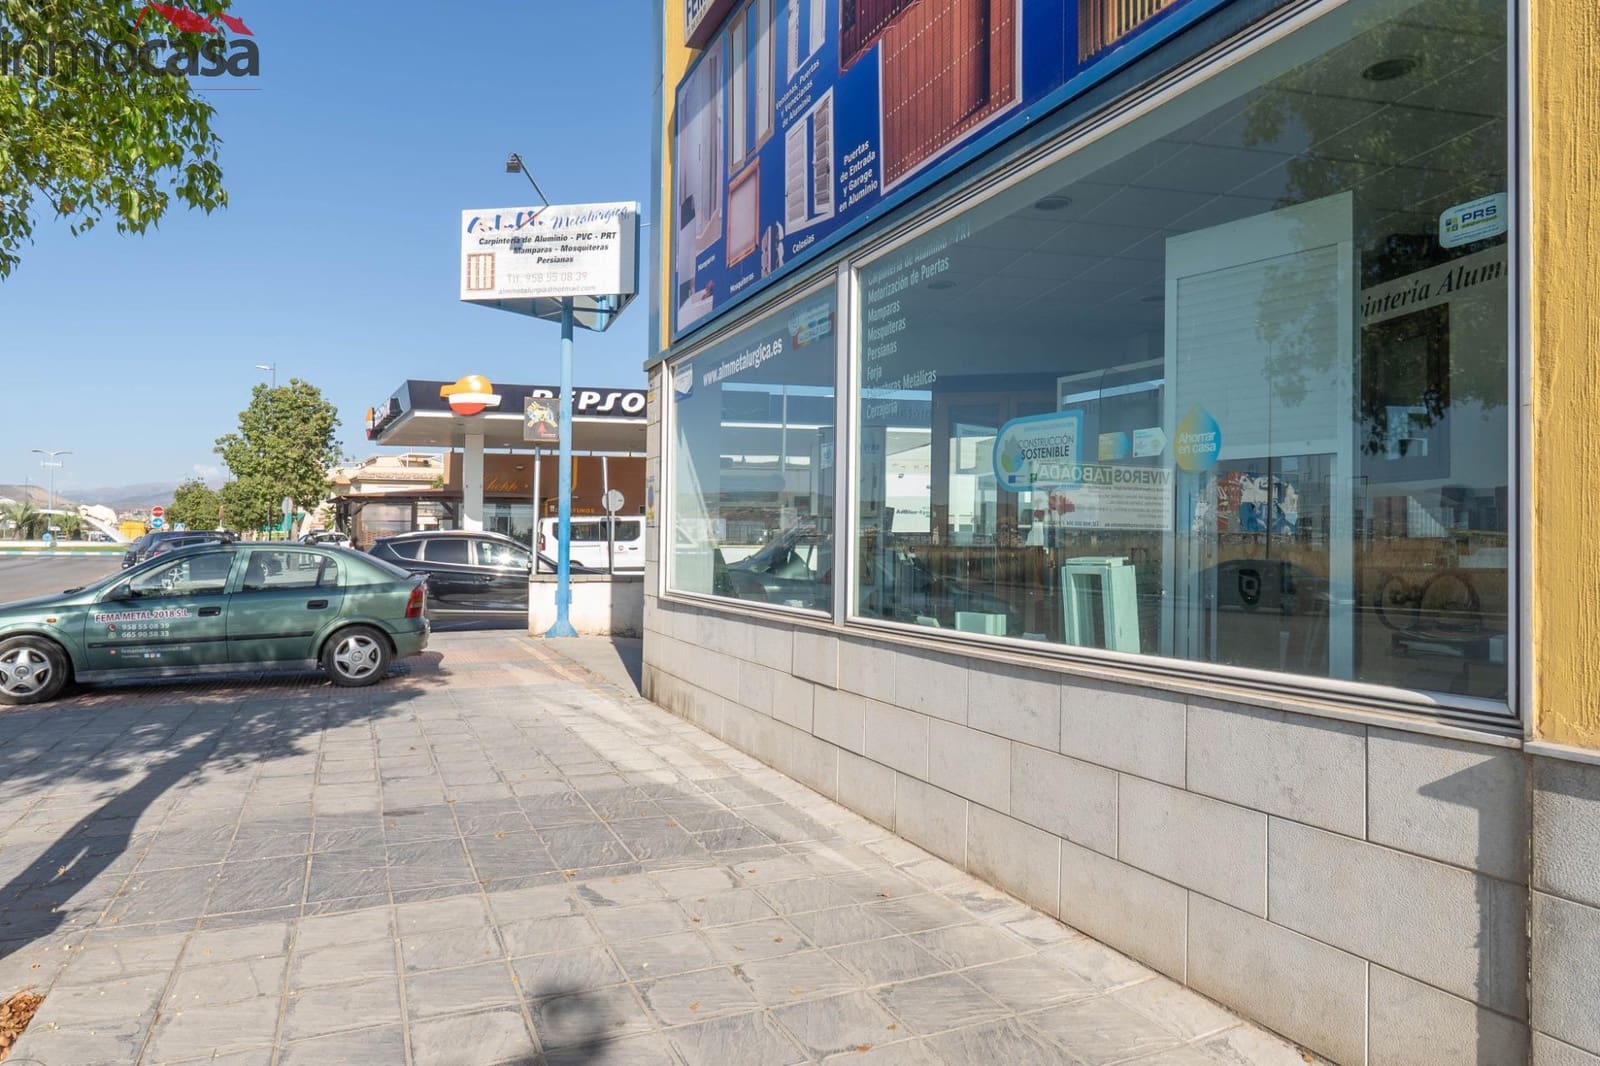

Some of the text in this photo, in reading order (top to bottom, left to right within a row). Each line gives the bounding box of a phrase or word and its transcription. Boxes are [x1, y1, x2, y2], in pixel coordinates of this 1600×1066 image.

[843, 140, 869, 166] Puertas
[840, 150, 876, 183] de Entrada
[848, 168, 873, 191] Garage
[838, 180, 878, 213] en Aluminio
[1461, 205, 1497, 223] PRS
[522, 235, 533, 244] de
[534, 233, 568, 243] Aluminio
[576, 233, 593, 241] PVC
[600, 231, 617, 240] PRT
[513, 246, 553, 255] Mamparas
[560, 243, 609, 254] Mosquiteras
[536, 255, 574, 264] Persianas
[910, 270, 920, 286] de
[921, 255, 950, 280] Puertas
[867, 299, 901, 323] Mamparas
[867, 316, 907, 344] Mosquiteras
[867, 340, 898, 362] Persianas
[1018, 434, 1074, 449] CONSTRUCCIÓN
[1178, 430, 1216, 443] Ahorrar
[1021, 446, 1070, 460] SOSTENIBLE
[1177, 442, 1216, 453] en casa
[95, 613, 122, 622] FEMA
[122, 611, 152, 621] METAL
[153, 609, 175, 619] 2018
